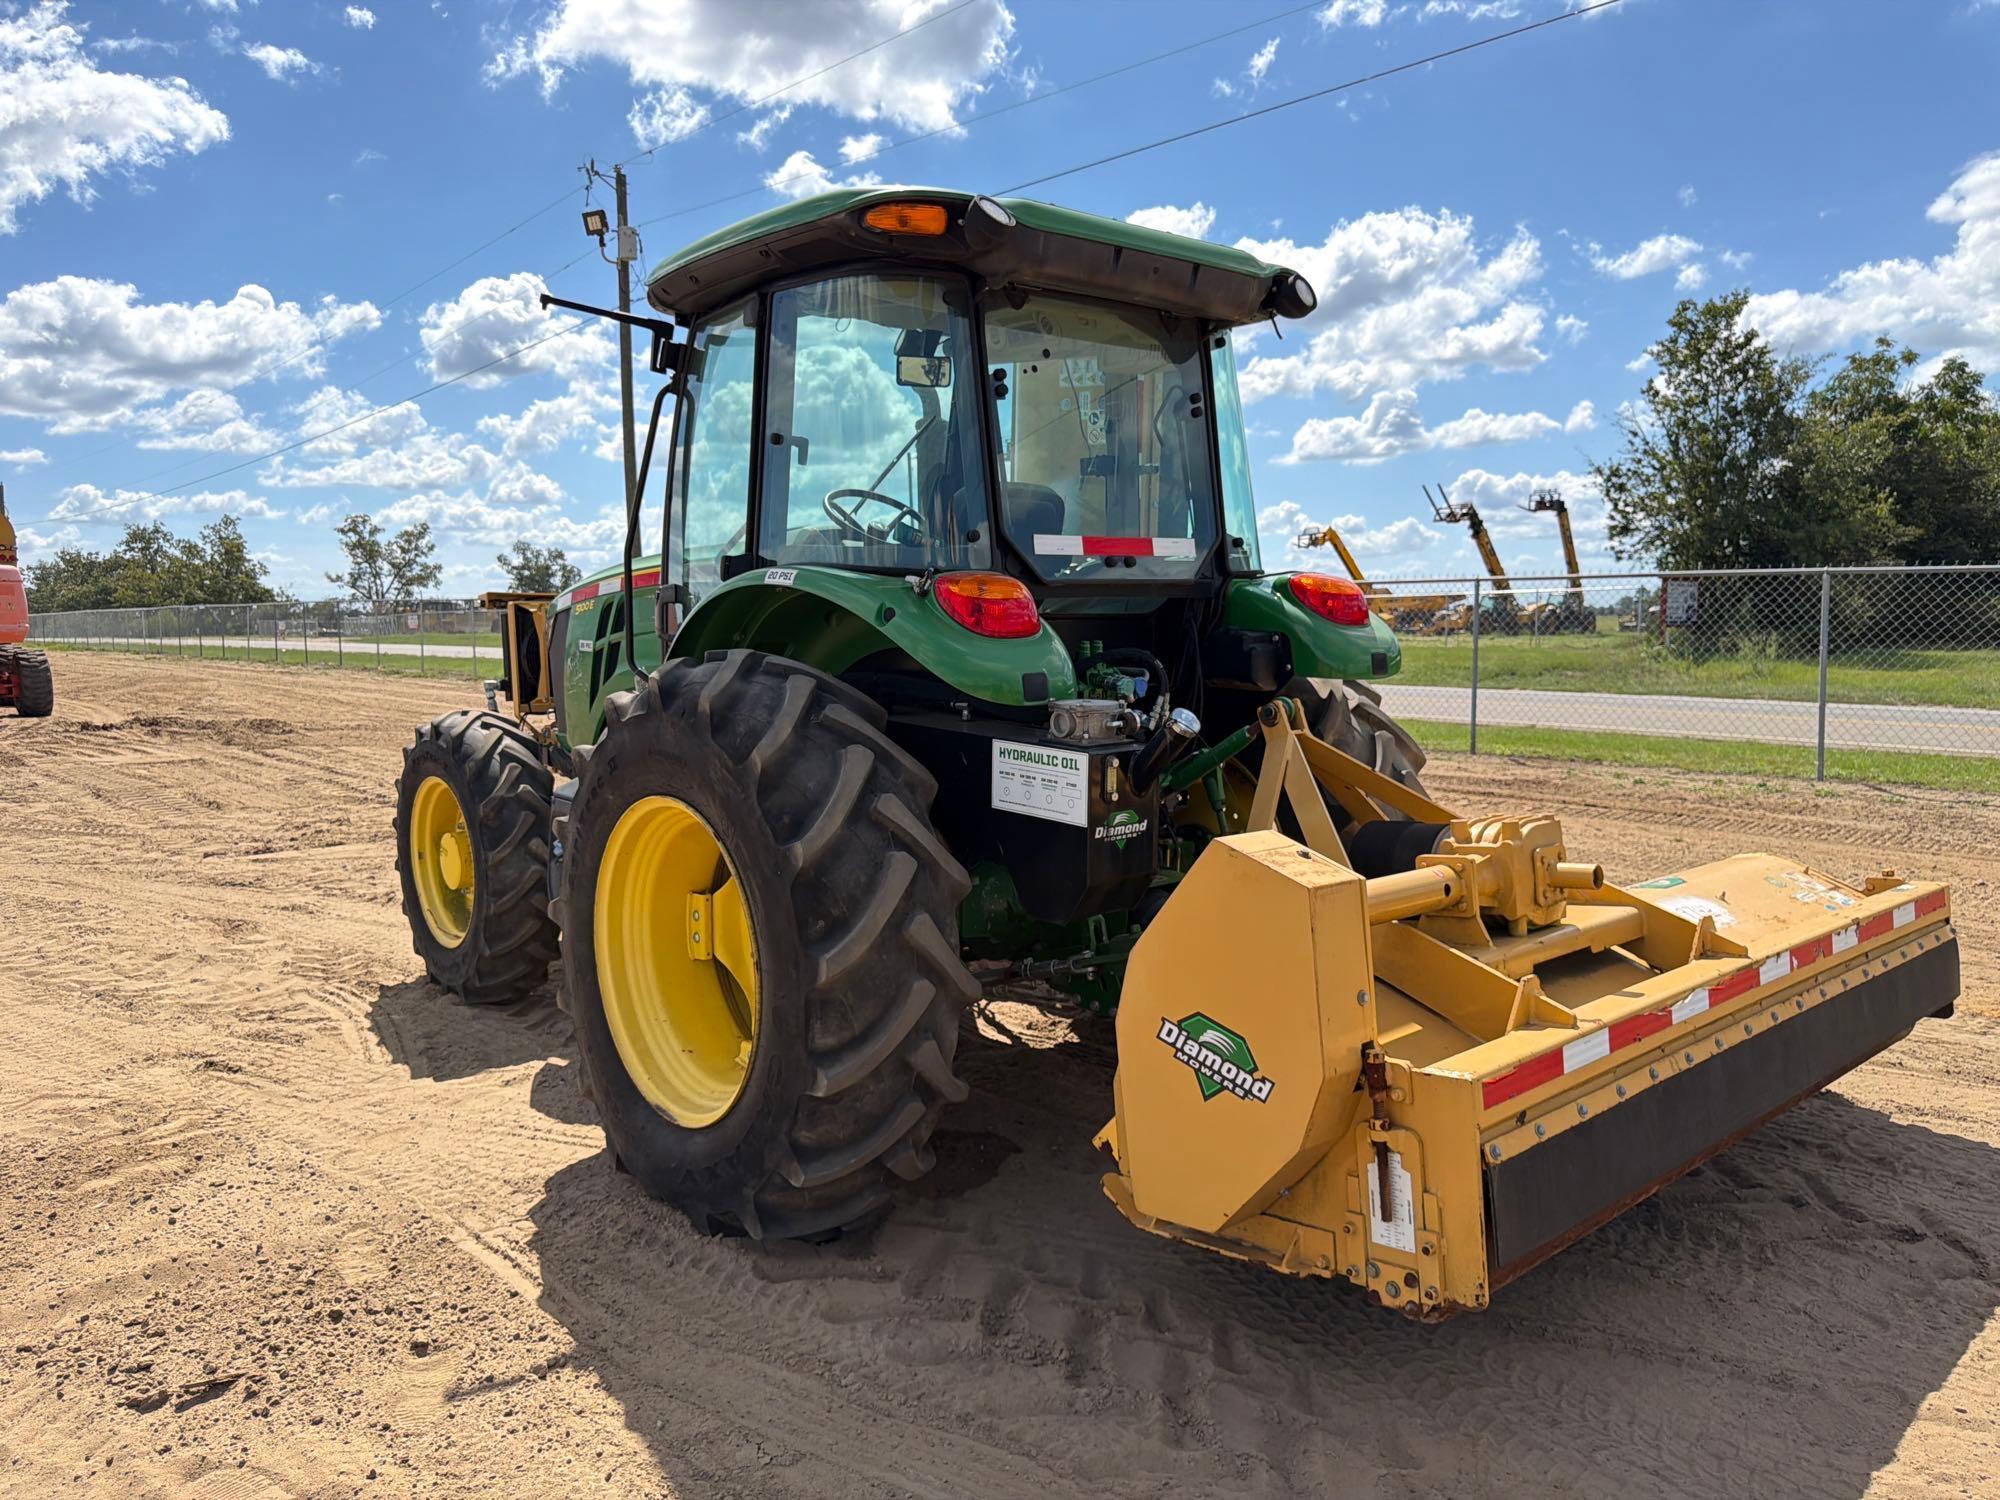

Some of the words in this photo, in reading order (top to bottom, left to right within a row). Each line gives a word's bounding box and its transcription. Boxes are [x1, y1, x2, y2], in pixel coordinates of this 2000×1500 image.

[778, 572, 794, 581] PSI
[999, 746, 1059, 768] HYDRAULIC
[1061, 757, 1080, 771] OIL
[1094, 819, 1148, 839] Diamond
[1159, 1020, 1273, 1101] Diamond
[1176, 1051, 1245, 1097] MOWERS
